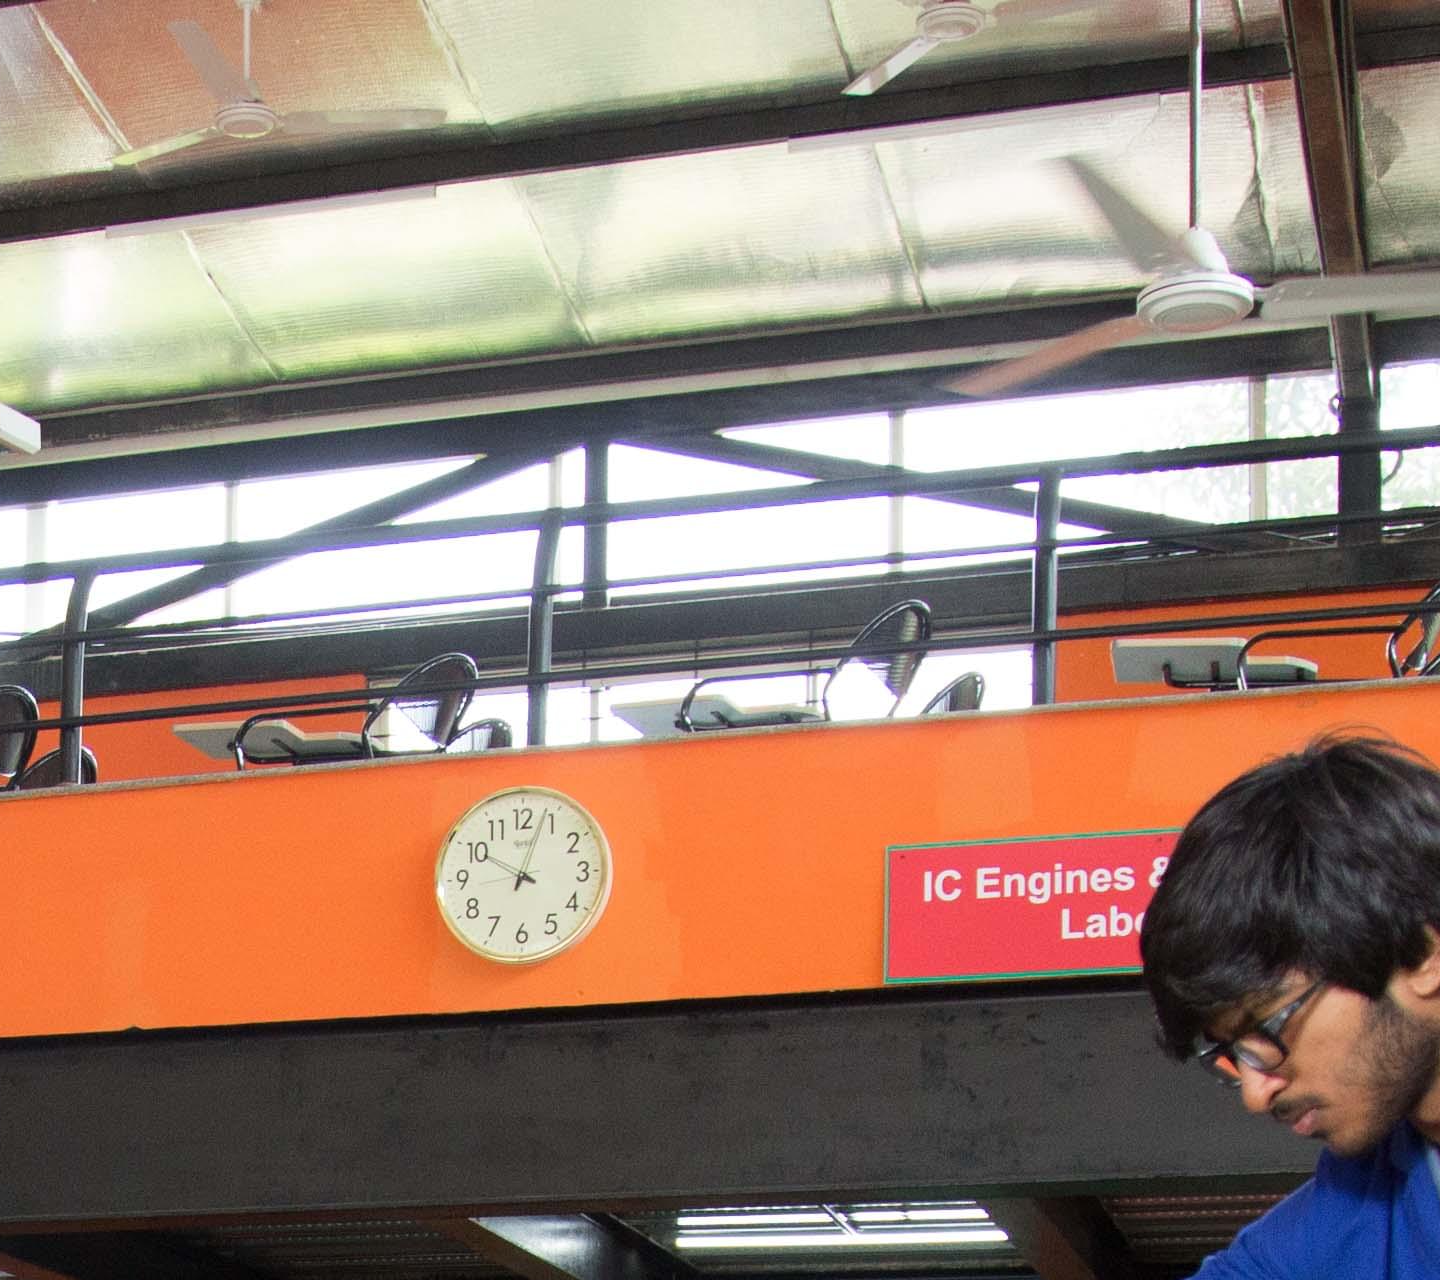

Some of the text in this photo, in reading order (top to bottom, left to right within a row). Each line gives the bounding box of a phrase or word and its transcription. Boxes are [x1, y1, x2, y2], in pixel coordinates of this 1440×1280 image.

[487, 819, 505, 841] 11
[512, 808, 533, 831] 12
[547, 813, 555, 835] 1
[467, 841, 489, 863] 10
[566, 832, 580, 854] 2
[456, 869, 469, 890] 9
[575, 861, 590, 883] 3
[923, 868, 962, 902] IC
[975, 863, 1136, 904] Engines
[465, 898, 480, 919] 8
[565, 892, 579, 911] 4
[487, 916, 502, 937] 7
[515, 923, 529, 944] 6
[544, 913, 558, 935] 5
